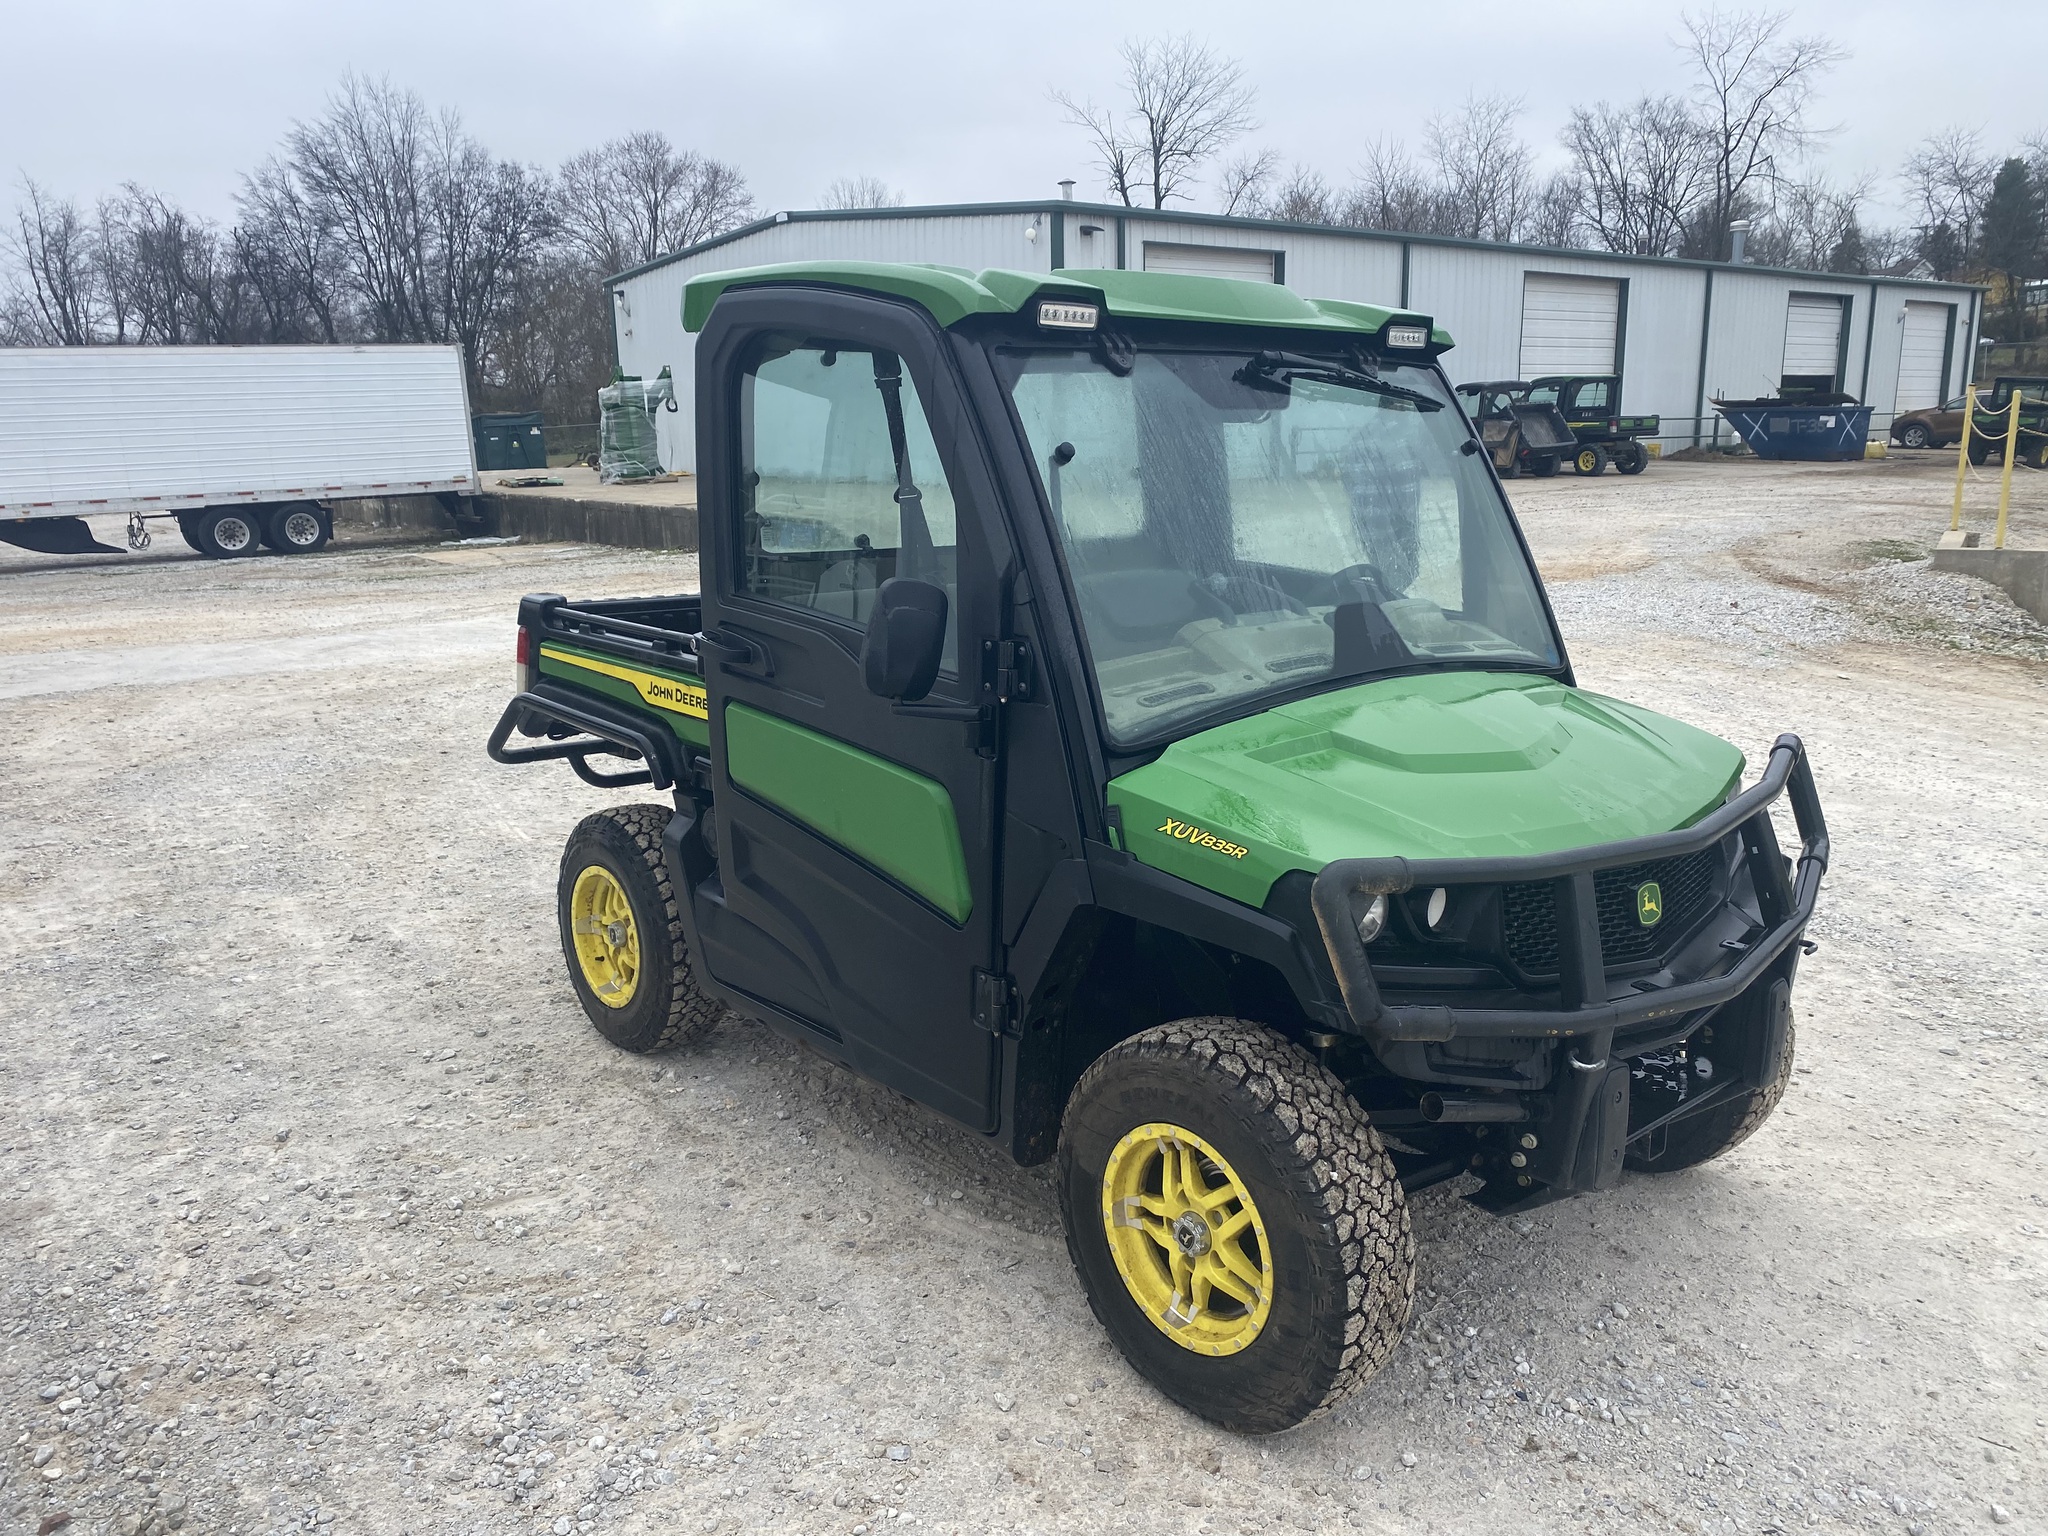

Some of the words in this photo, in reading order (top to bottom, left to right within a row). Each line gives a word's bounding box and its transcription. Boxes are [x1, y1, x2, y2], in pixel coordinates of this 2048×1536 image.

[647, 681, 673, 701] JOHN
[675, 688, 708, 710] DEERE
[1157, 817, 1248, 860] XUV835R
